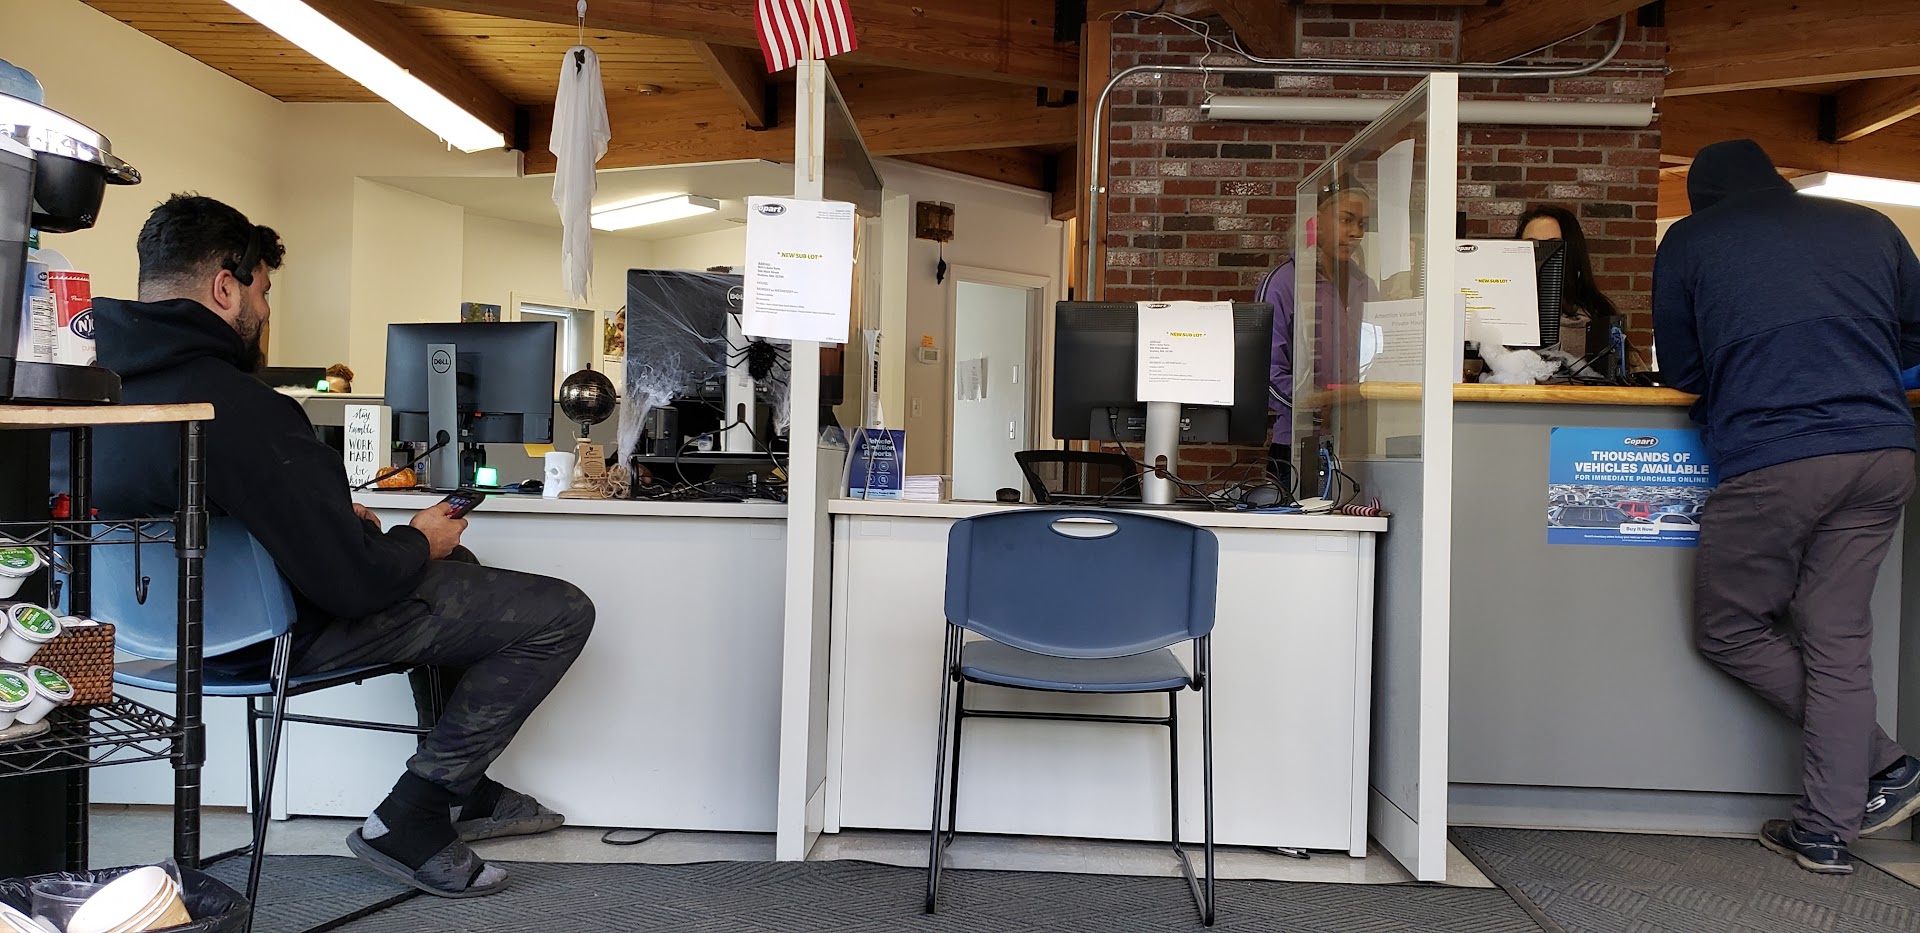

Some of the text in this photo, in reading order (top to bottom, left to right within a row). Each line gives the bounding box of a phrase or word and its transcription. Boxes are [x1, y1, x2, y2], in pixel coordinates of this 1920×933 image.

[353, 408, 371, 423] stay
[349, 438, 373, 450] WORK
[1624, 437, 1654, 446] Copart
[349, 450, 374, 462] HARD
[1591, 450, 1691, 463] THOUSANDS OF
[1574, 462, 1710, 475] VEHICLES AVAILABLE
